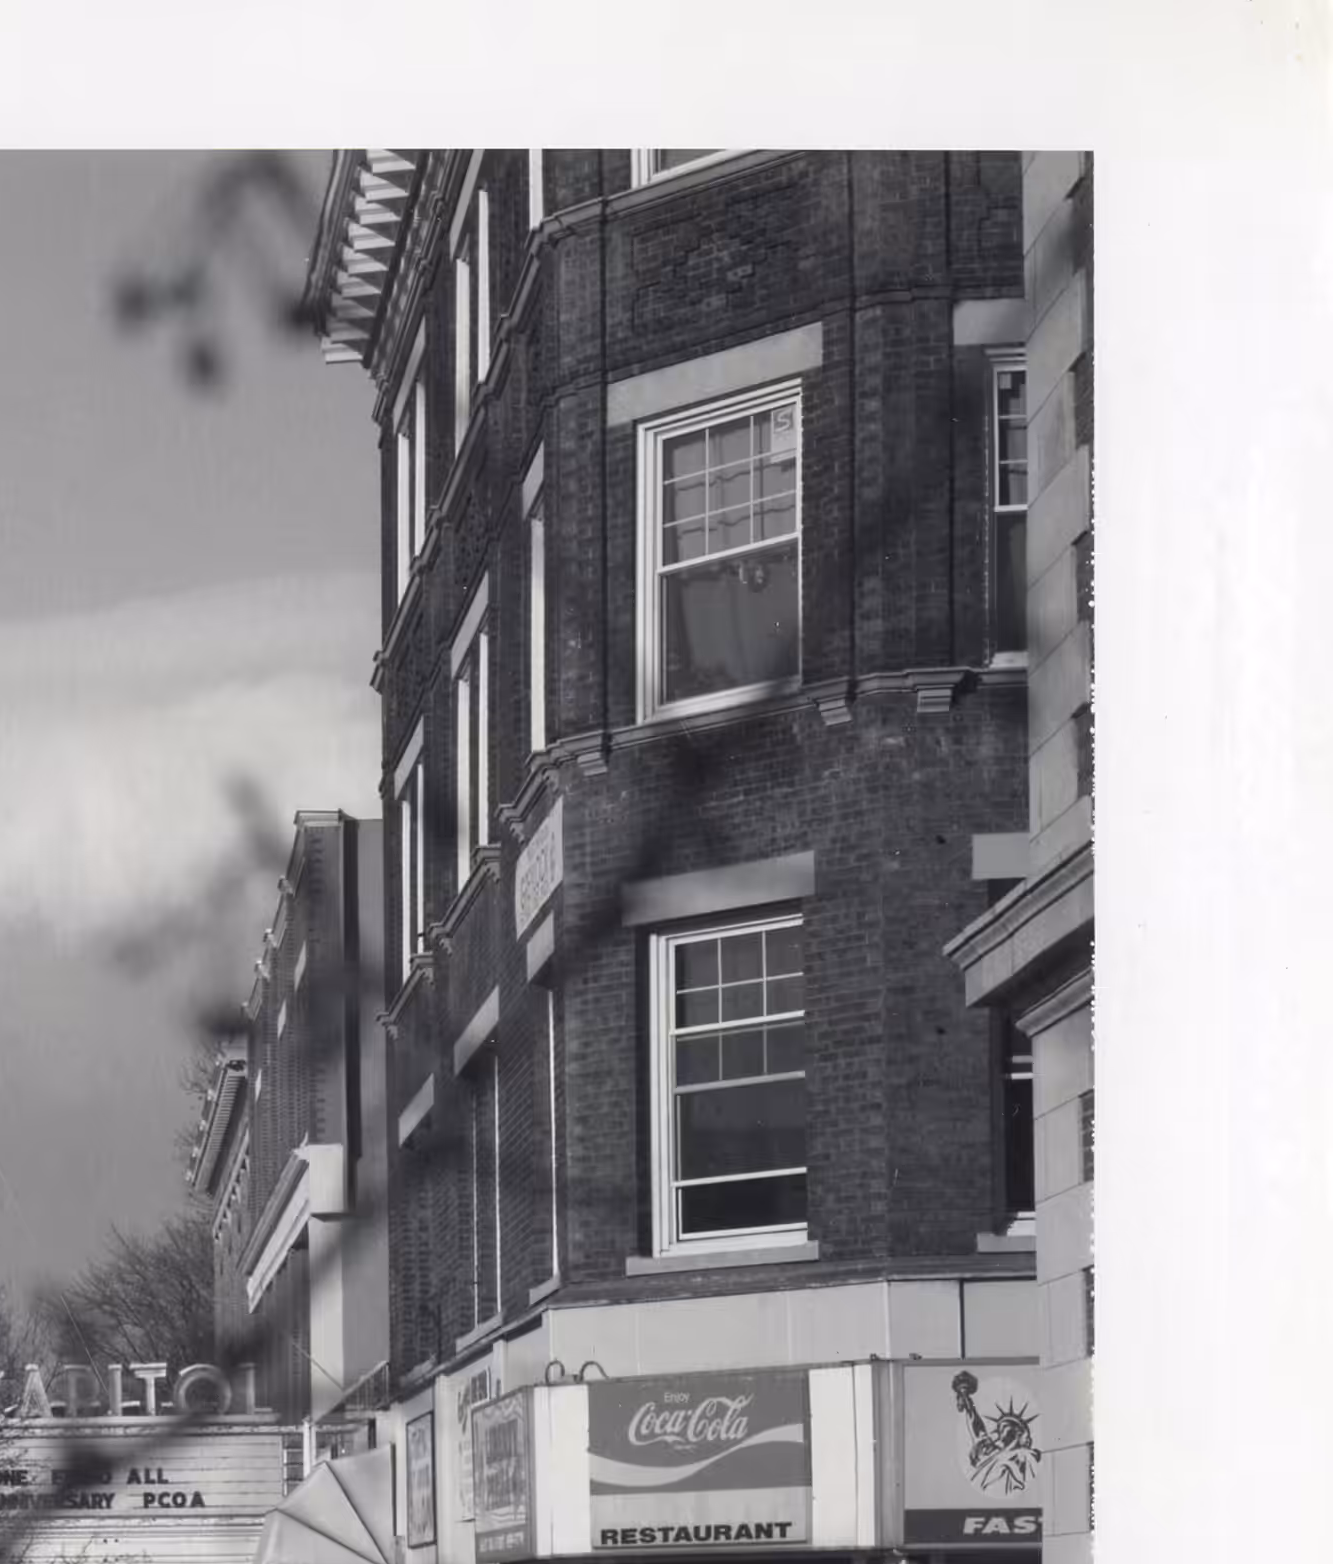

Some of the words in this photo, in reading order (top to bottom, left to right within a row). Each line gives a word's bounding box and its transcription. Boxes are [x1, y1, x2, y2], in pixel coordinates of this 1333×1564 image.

[663, 1392, 690, 1404] Enjoy
[628, 1393, 754, 1446] Coca-Cola
[126, 1468, 169, 1485] ALL
[600, 1522, 792, 1546] RESTAURANT
